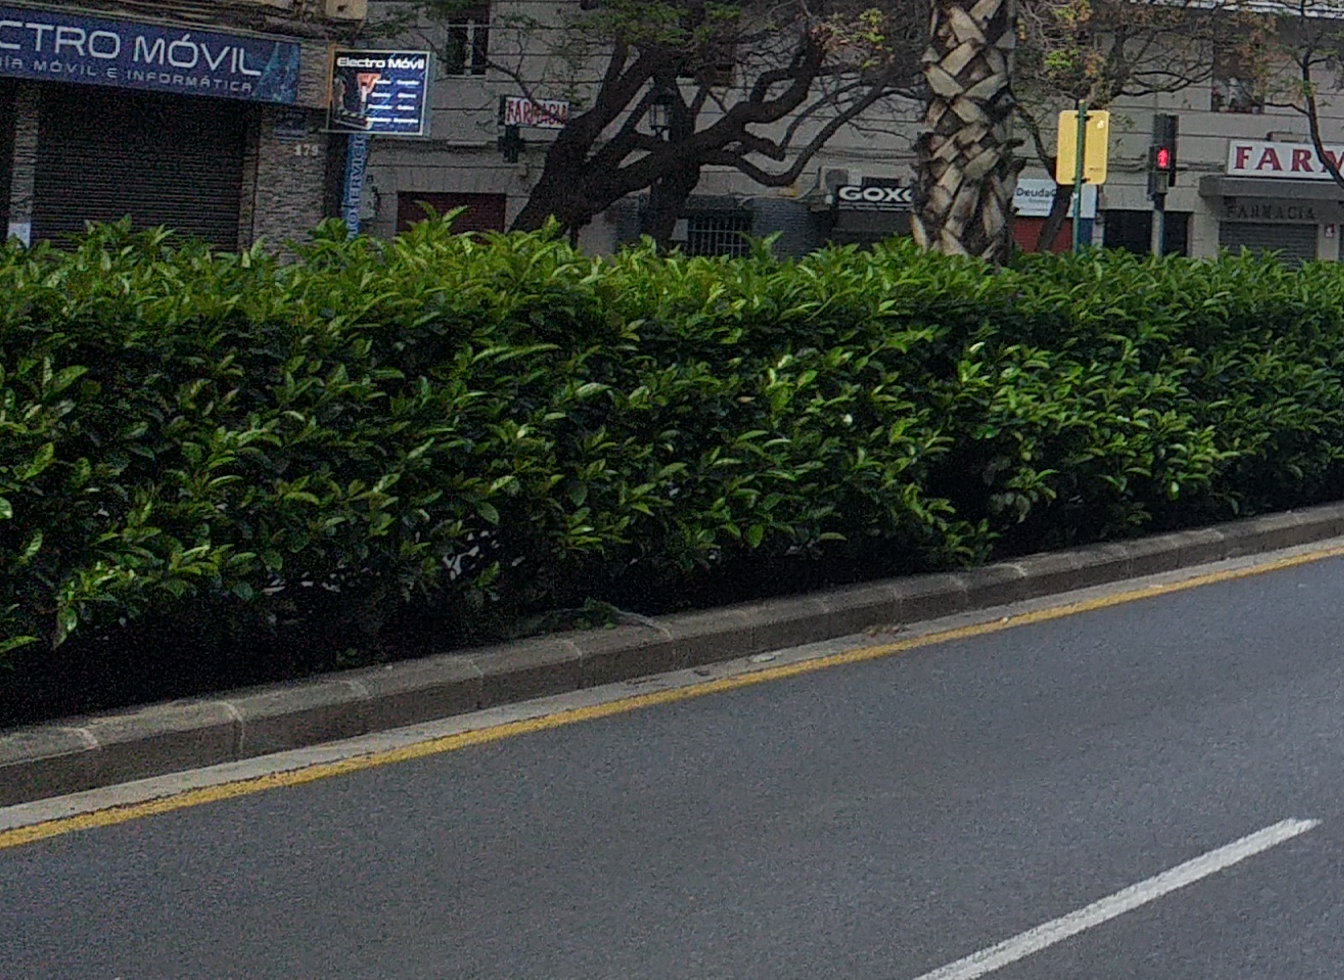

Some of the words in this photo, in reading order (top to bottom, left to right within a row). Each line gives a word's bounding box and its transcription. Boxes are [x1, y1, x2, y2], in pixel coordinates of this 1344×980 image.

[133, 33, 262, 77] MÓVIL
[337, 57, 386, 68] Electro
[388, 57, 425, 69] Móvil
[33, 60, 96, 77] MÓVIL
[127, 70, 253, 92] INFORMÁTICA
[1227, 204, 1316, 220] FARMACIA
